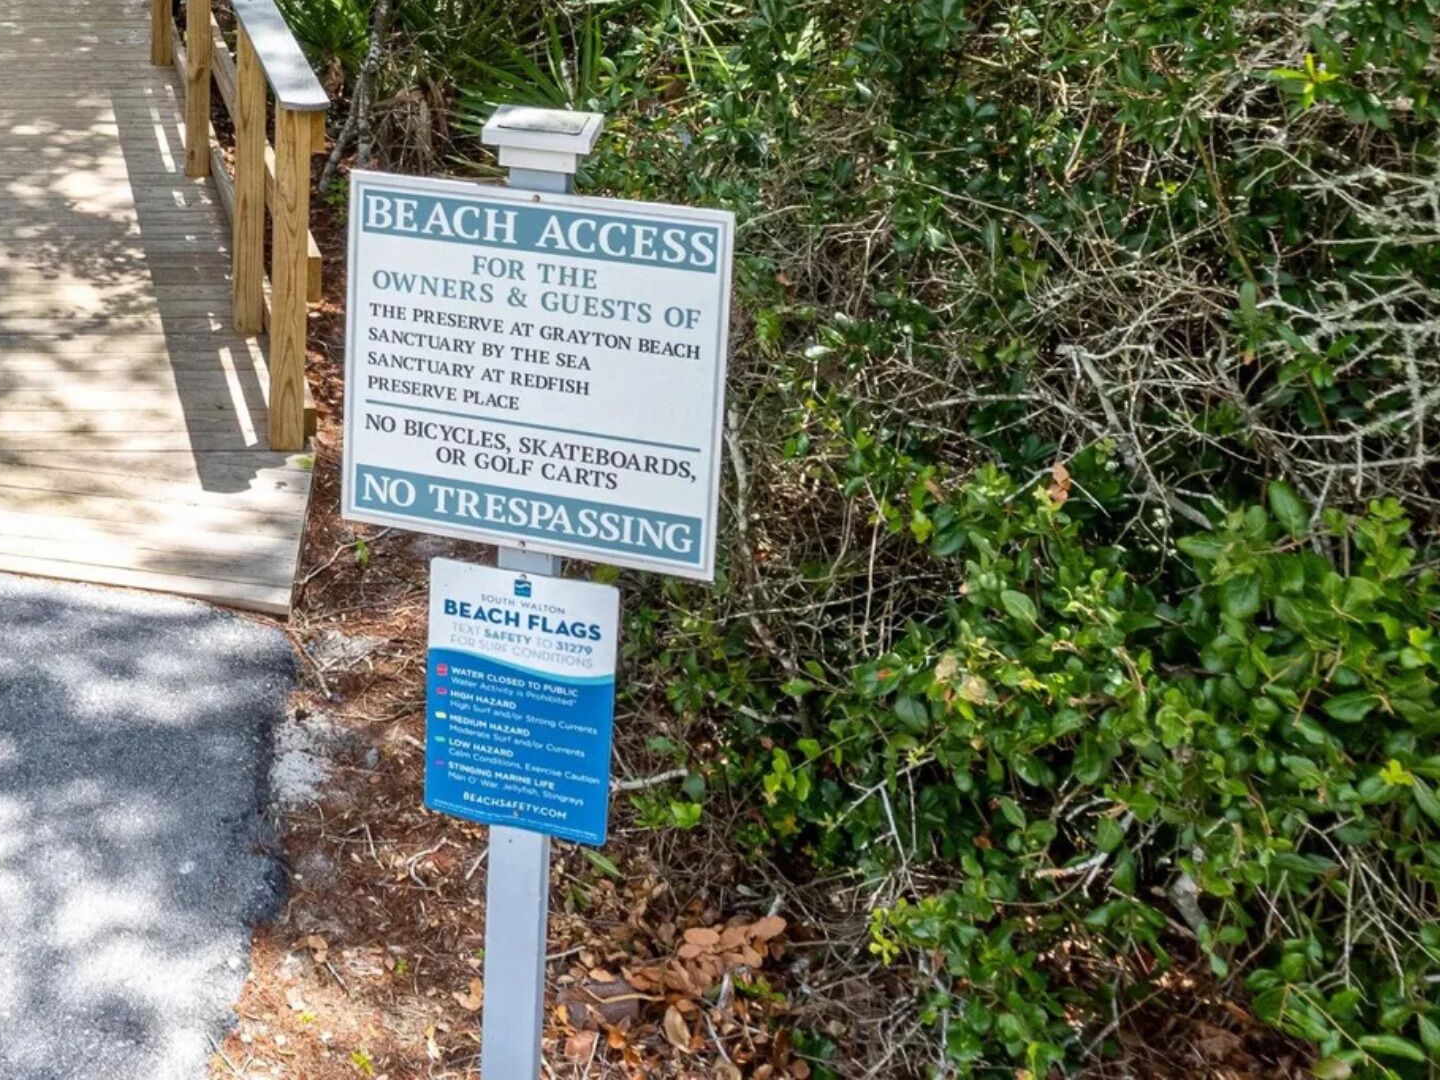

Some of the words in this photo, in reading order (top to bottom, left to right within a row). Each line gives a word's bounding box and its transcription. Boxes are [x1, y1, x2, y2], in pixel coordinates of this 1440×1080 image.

[365, 196, 517, 244] BEACH
[537, 215, 714, 267] ACCESS
[472, 256, 525, 280] FOR
[538, 264, 597, 289] THE
[373, 270, 493, 303] OWNERS
[507, 287, 527, 308] &
[541, 291, 652, 323] GUESTS
[664, 307, 701, 329] OF
[370, 303, 406, 320] THE
[413, 309, 503, 334] PRESERVE
[510, 322, 533, 337] AT
[540, 325, 631, 350] GRAYTON
[638, 339, 700, 359] BEACH
[368, 328, 475, 355] SANCTUARY
[482, 343, 504, 359] BY
[511, 347, 549, 364] THE
[556, 353, 590, 371] SEA
[368, 352, 474, 379] SANCTUARY
[481, 368, 504, 383] AT
[511, 372, 589, 395] REDFISH
[368, 376, 456, 401] PRESERVE
[463, 390, 519, 410] PLACE
[366, 414, 395, 433] NO
[405, 420, 511, 455] BICYCLES,
[520, 438, 696, 483] SKATEBOARDS,
[436, 447, 465, 465] OR
[475, 452, 533, 476] GOLF
[541, 464, 617, 489] CARTS
[362, 474, 415, 506] NO
[429, 485, 692, 553] TRESPASSING
[444, 600, 519, 628] BEACH
[528, 615, 601, 641] FLAGS
[481, 594, 515, 606] SOUTH
[520, 601, 565, 615] WALTON
[451, 635, 475, 648] FOR
[479, 640, 507, 653] SURF
[513, 646, 592, 668] CONDITIONS
[453, 622, 480, 634] TEXT
[484, 629, 532, 644] SAFETY
[536, 637, 552, 648] TO
[556, 640, 592, 655] 31279
[451, 667, 484, 679] WATER
[487, 674, 524, 687] CLOSED
[528, 679, 541, 690] TO
[543, 683, 578, 697] PUBLIC
[451, 678, 477, 688] Water
[480, 683, 514, 696] Activity
[451, 690, 473, 701] HIGH
[476, 696, 517, 710] HAZARD
[450, 701, 471, 711] High
[474, 705, 491, 715] Surf
[526, 715, 556, 728] Strong
[559, 721, 598, 735] Currents
[450, 714, 487, 729] MEDIUM
[490, 723, 530, 736] HAZARD
[449, 739, 471, 749] LOW
[473, 744, 514, 757] HAZARD
[450, 725, 490, 739] Moderate
[493, 732, 511, 743] Surf
[546, 744, 585, 757] Currents
[448, 749, 470, 759] Calm
[525, 764, 562, 777] Exercise
[564, 770, 600, 784] Caution
[448, 761, 492, 777] STINGING
[495, 772, 532, 785] MARINE
[534, 780, 555, 790] LIFE
[448, 772, 468, 782] Man
[543, 790, 584, 806] Stingrays
[463, 792, 567, 819] BEACHSAFETY.COM
